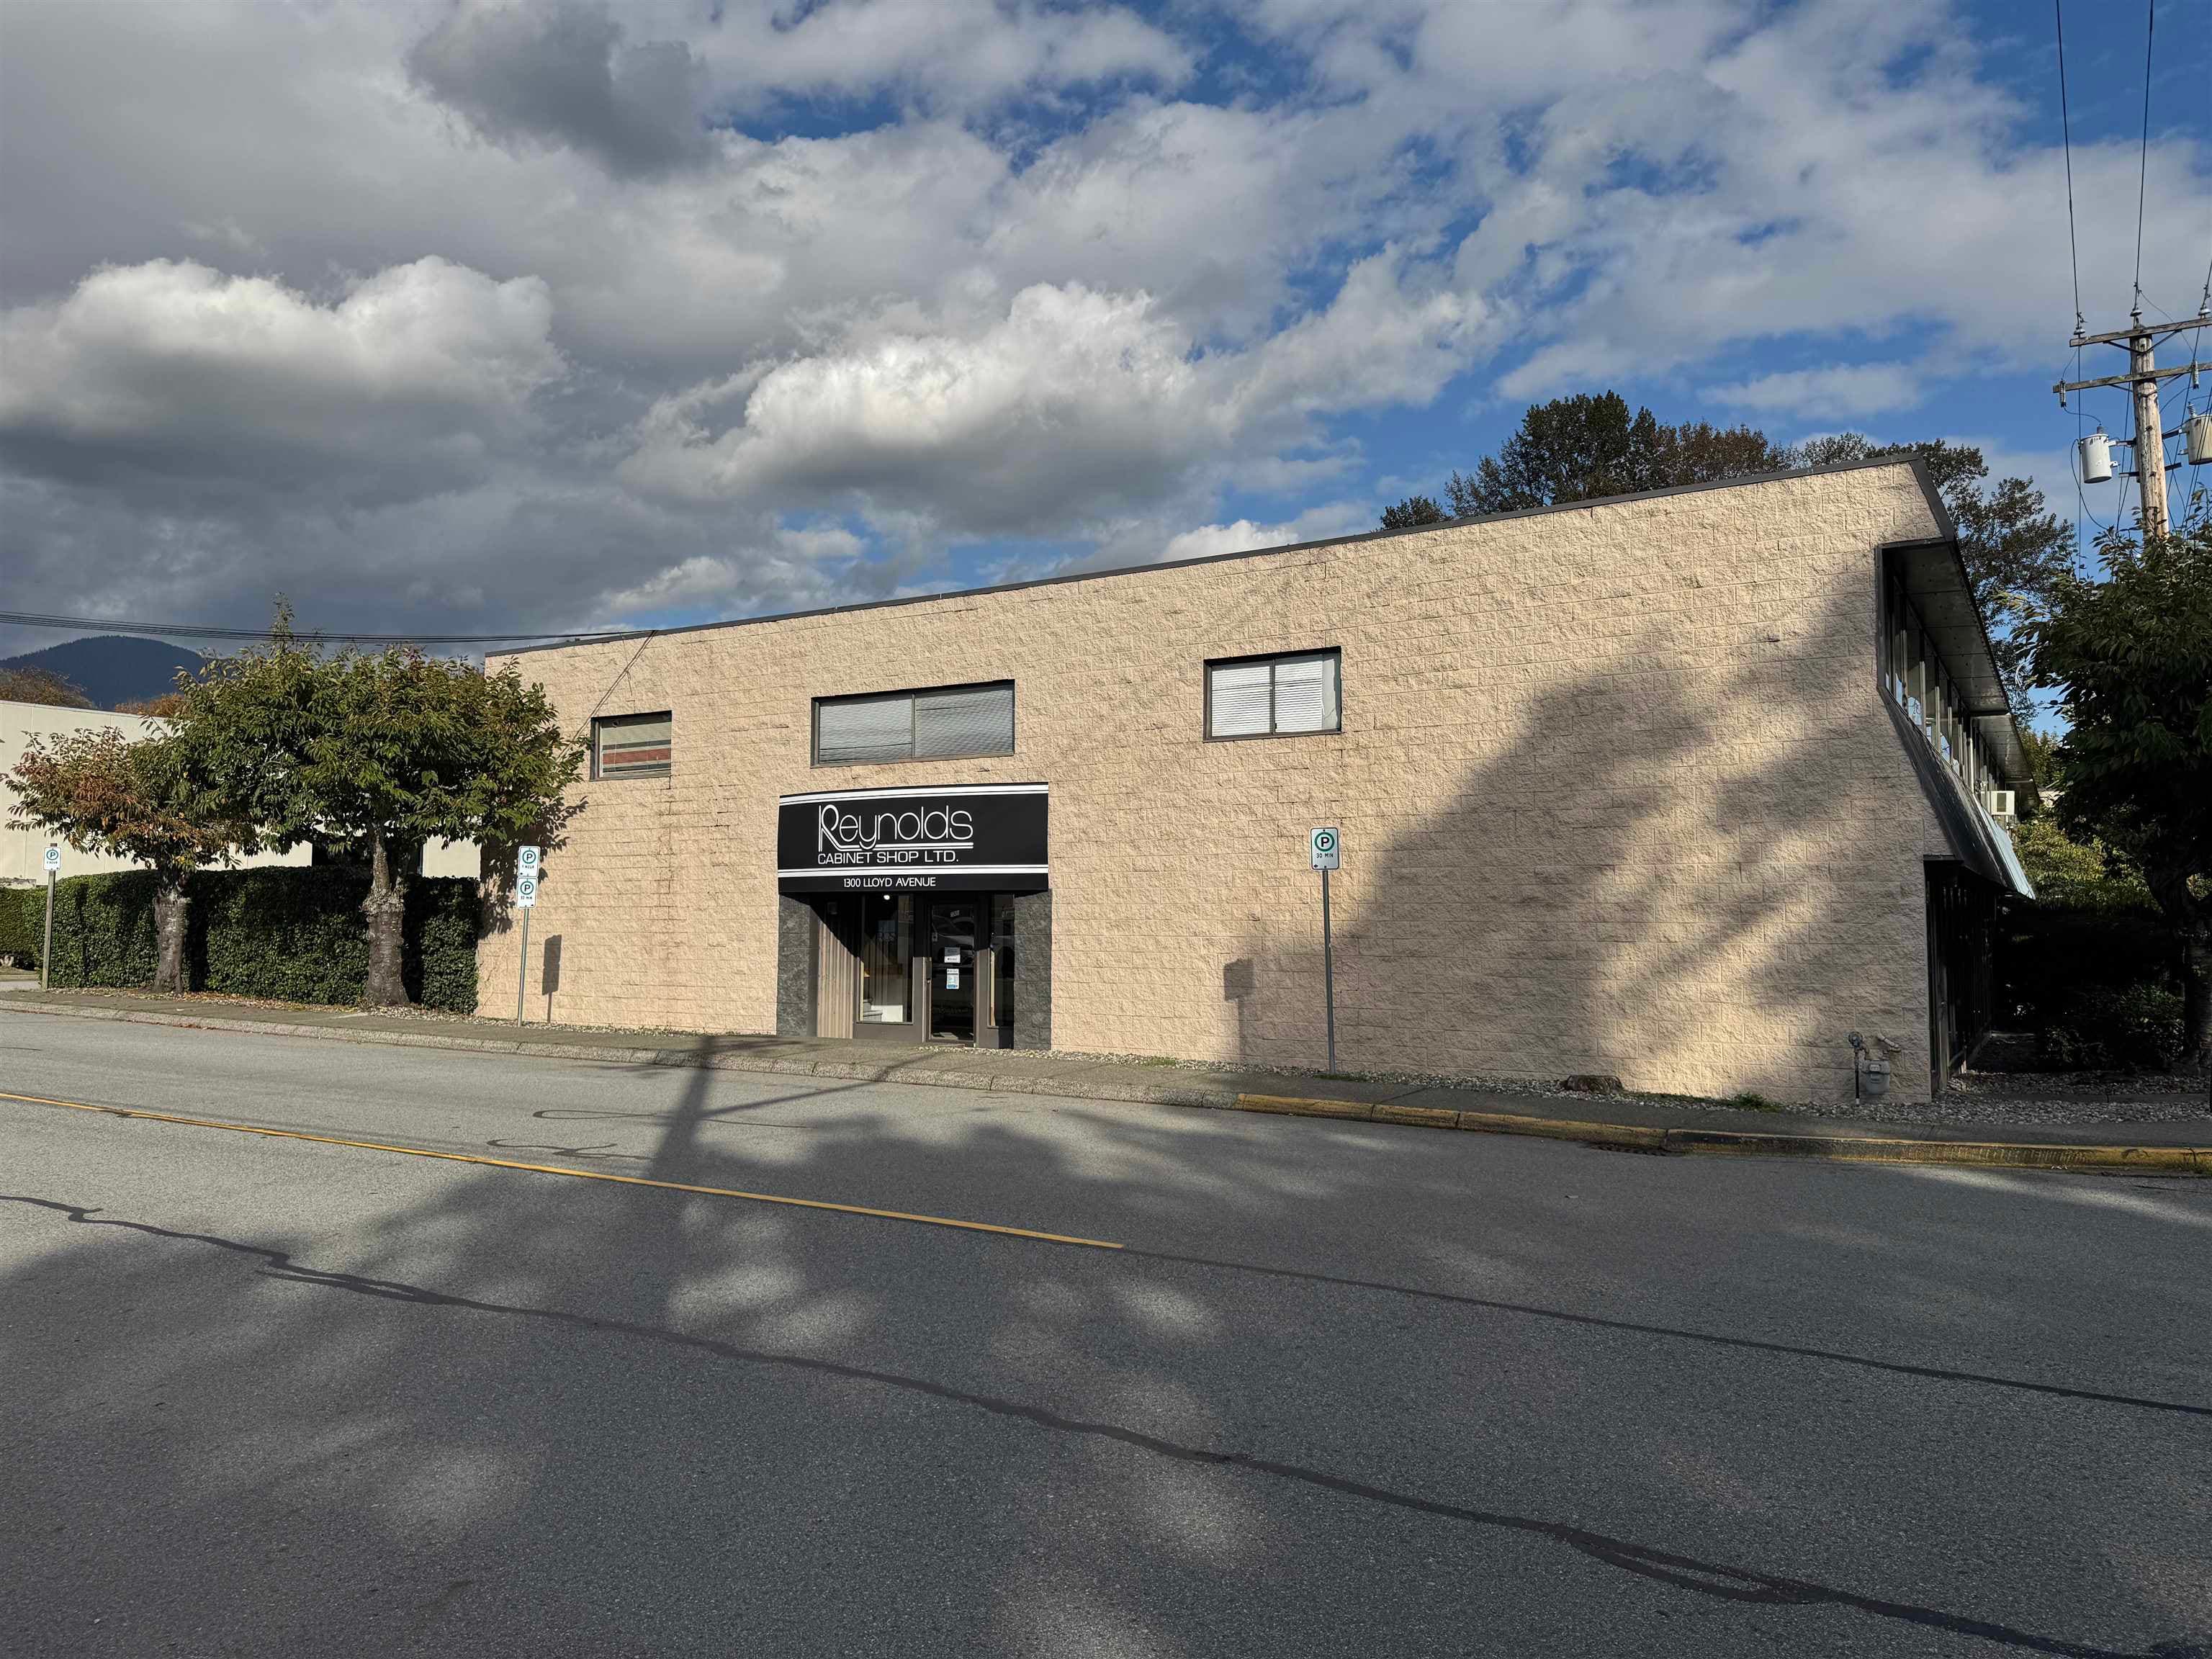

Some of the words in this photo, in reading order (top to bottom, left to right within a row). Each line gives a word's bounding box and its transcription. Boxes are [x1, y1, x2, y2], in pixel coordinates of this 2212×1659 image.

[818, 804, 974, 852] Reynolds
[1321, 836, 1330, 848] P
[818, 852, 873, 864] CABINET
[876, 851, 919, 863] SHOP
[925, 850, 959, 862] LTD.
[843, 878, 861, 887] 1300
[863, 878, 892, 887] LLOYD
[896, 876, 936, 887] AVENUE
